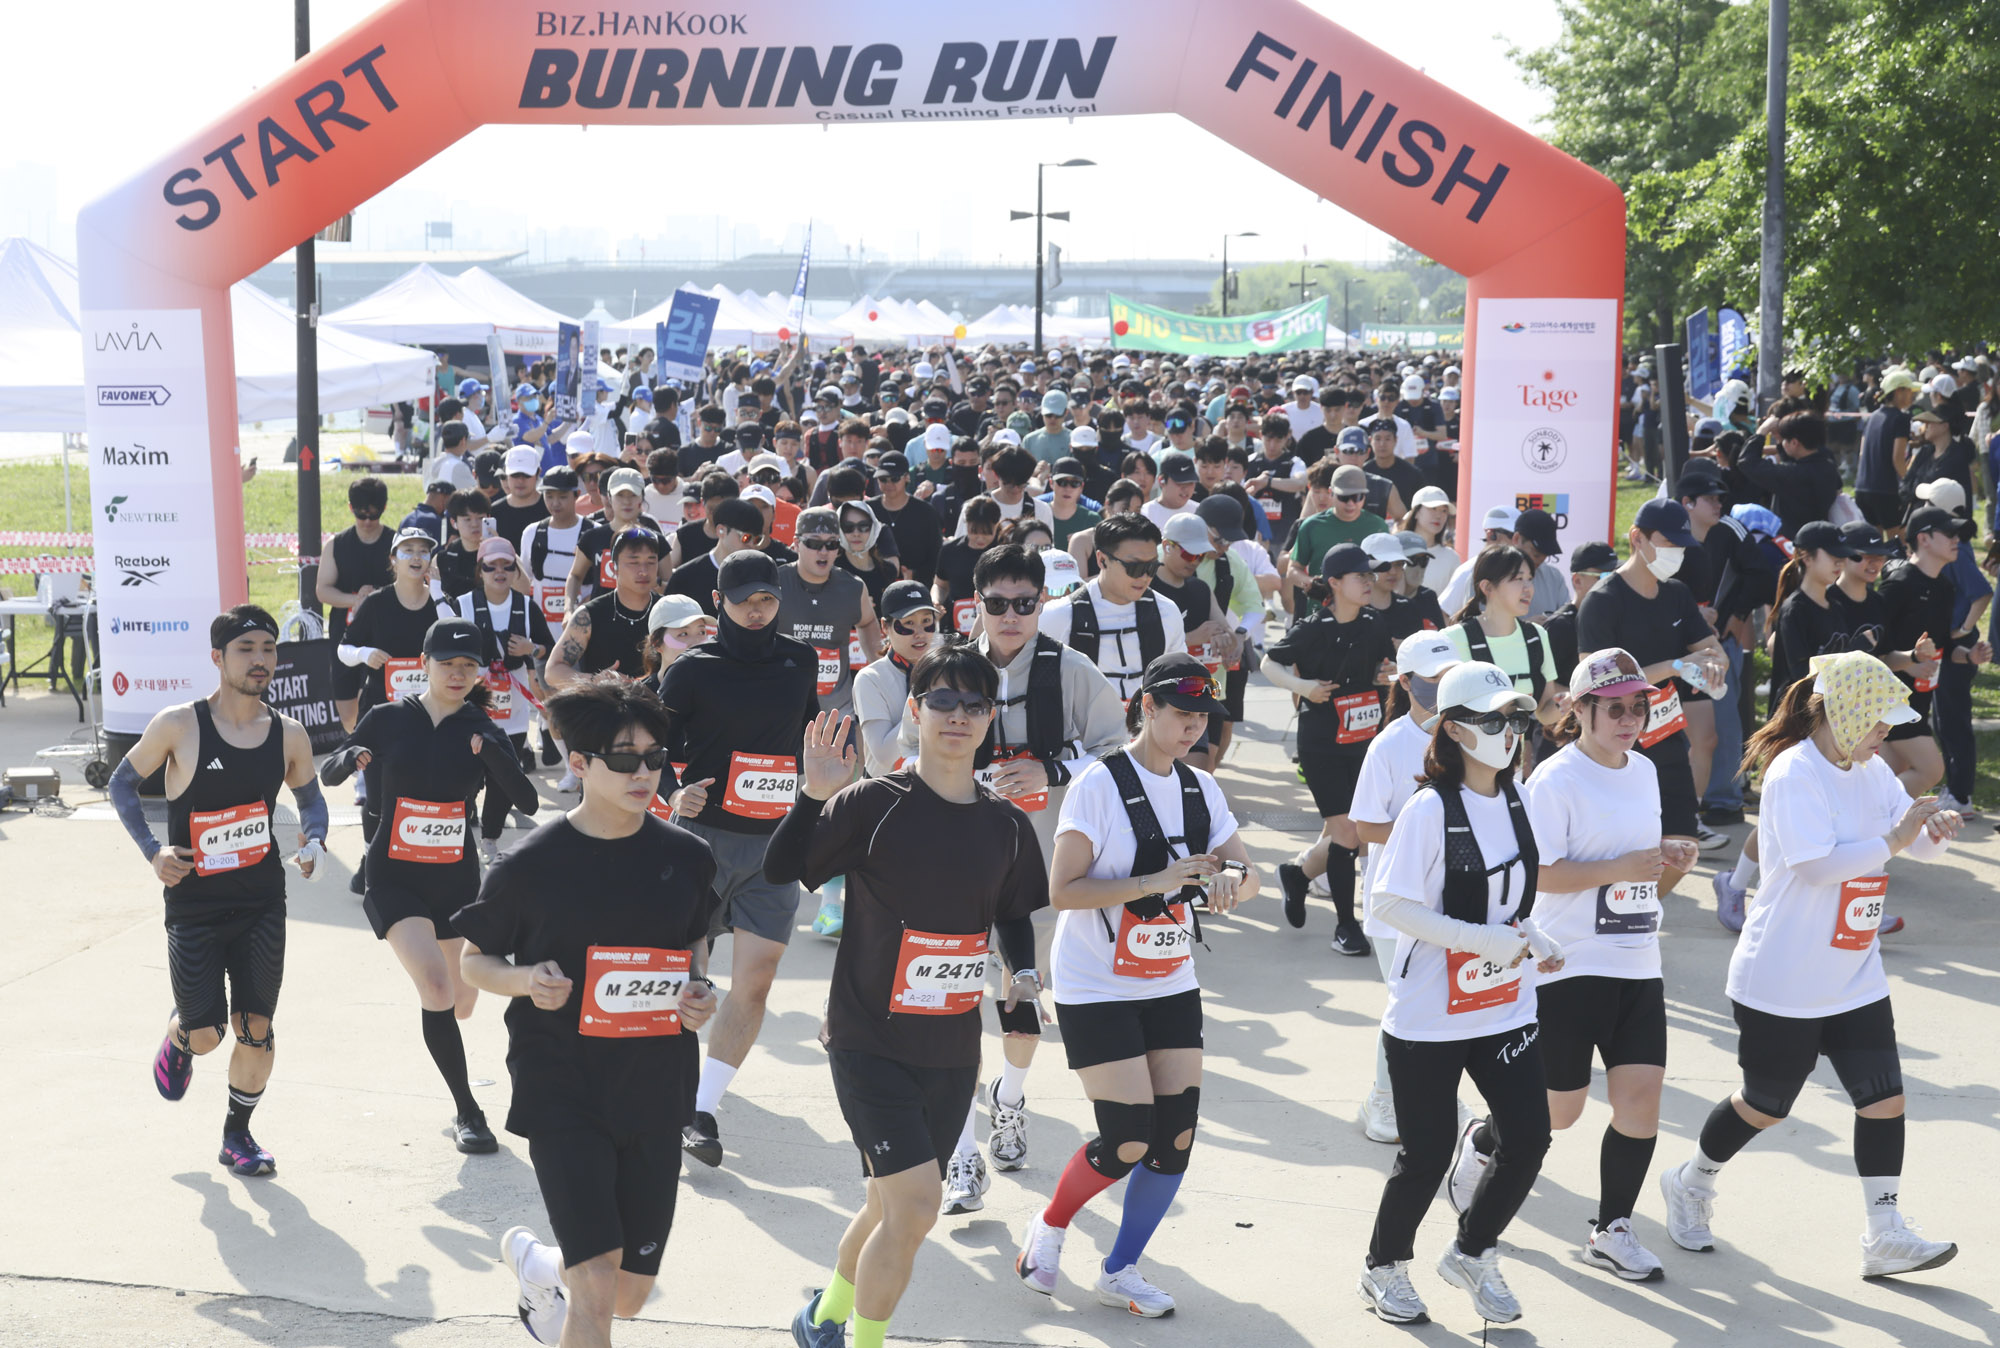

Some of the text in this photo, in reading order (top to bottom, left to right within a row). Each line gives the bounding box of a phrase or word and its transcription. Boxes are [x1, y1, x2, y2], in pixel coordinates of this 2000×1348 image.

[518, 36, 1117, 109] BURNING RUN
[816, 103, 1096, 121] Casual Running Festival
[1225, 31, 1510, 225] FINISH
[163, 45, 400, 232] START
[101, 390, 158, 403] FAVONEX
[1517, 384, 1578, 413] Tage
[1528, 428, 1562, 444] SUNBODY
[103, 443, 169, 465] Maxim
[119, 512, 179, 523] NEWTREE
[115, 555, 171, 568] Reebok
[793, 624, 834, 633] MORE MILES
[794, 631, 832, 640] LESS NOISE
[134, 678, 192, 692] 롯데웰푸드
[268, 675, 308, 703] START
[279, 701, 328, 727] AITING
[1357, 708, 1379, 721] 4147
[981, 772, 993, 783] M
[742, 778, 794, 791] M 2348
[207, 821, 265, 845] M 1460
[406, 824, 463, 836] W 4204
[209, 856, 235, 866] D-205
[1614, 890, 1626, 901] W
[1853, 907, 1864, 917] W
[907, 935, 963, 947] BURNING RUN
[1136, 933, 1151, 944] W
[592, 952, 632, 961] BURNING
[632, 953, 650, 961] RUN
[916, 961, 985, 979] M 2476
[1466, 968, 1479, 981] W
[605, 980, 683, 997] M 2421
[909, 994, 936, 1002] A-221
